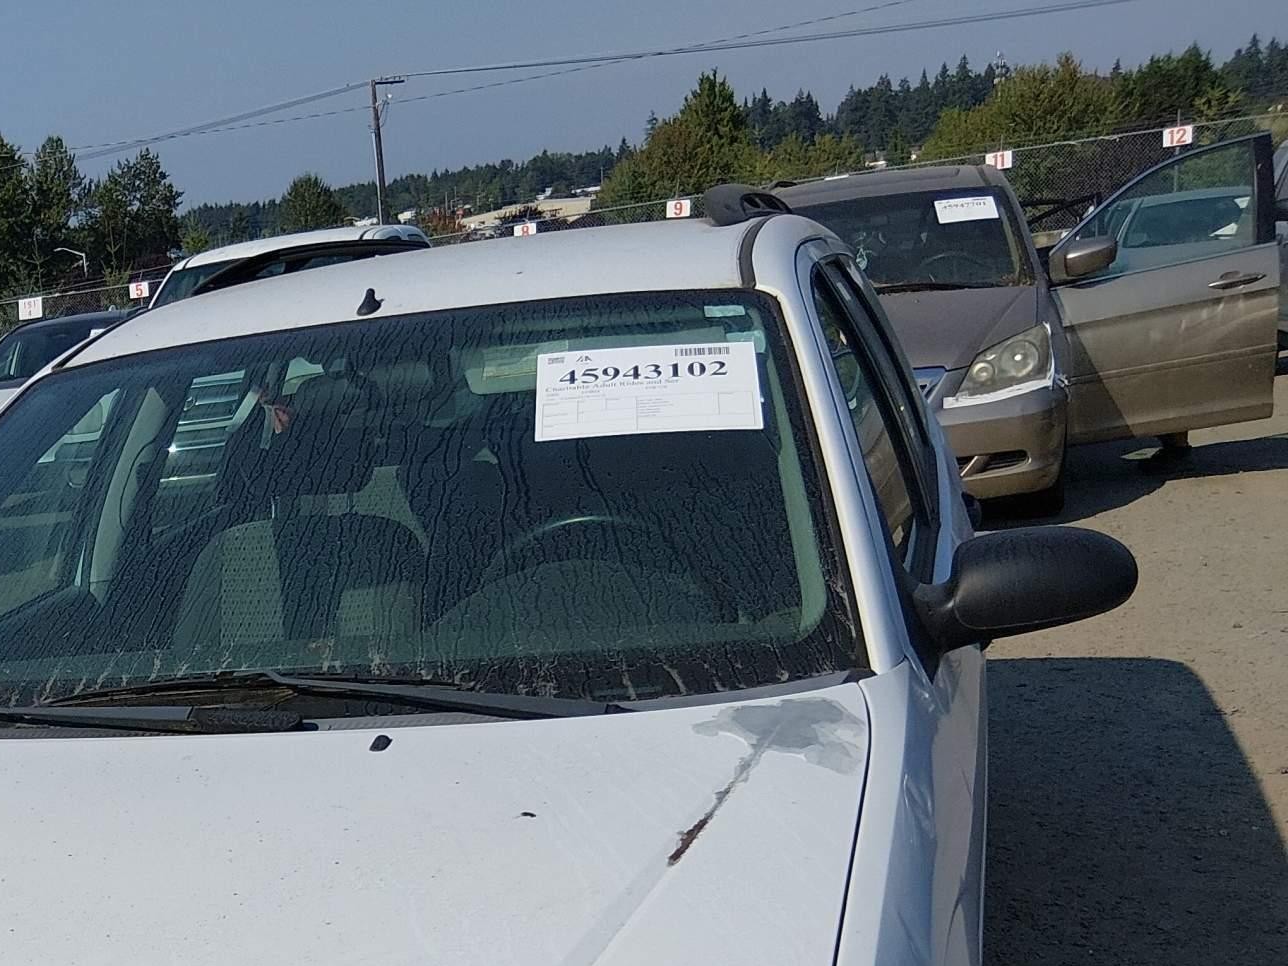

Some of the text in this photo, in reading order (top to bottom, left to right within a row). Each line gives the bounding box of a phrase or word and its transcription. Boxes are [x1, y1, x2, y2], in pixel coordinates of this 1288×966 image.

[1167, 128, 1187, 145] 12
[673, 201, 683, 216] 9
[521, 225, 530, 236] 8
[135, 283, 143, 297] 5
[559, 360, 728, 384] 45943102
